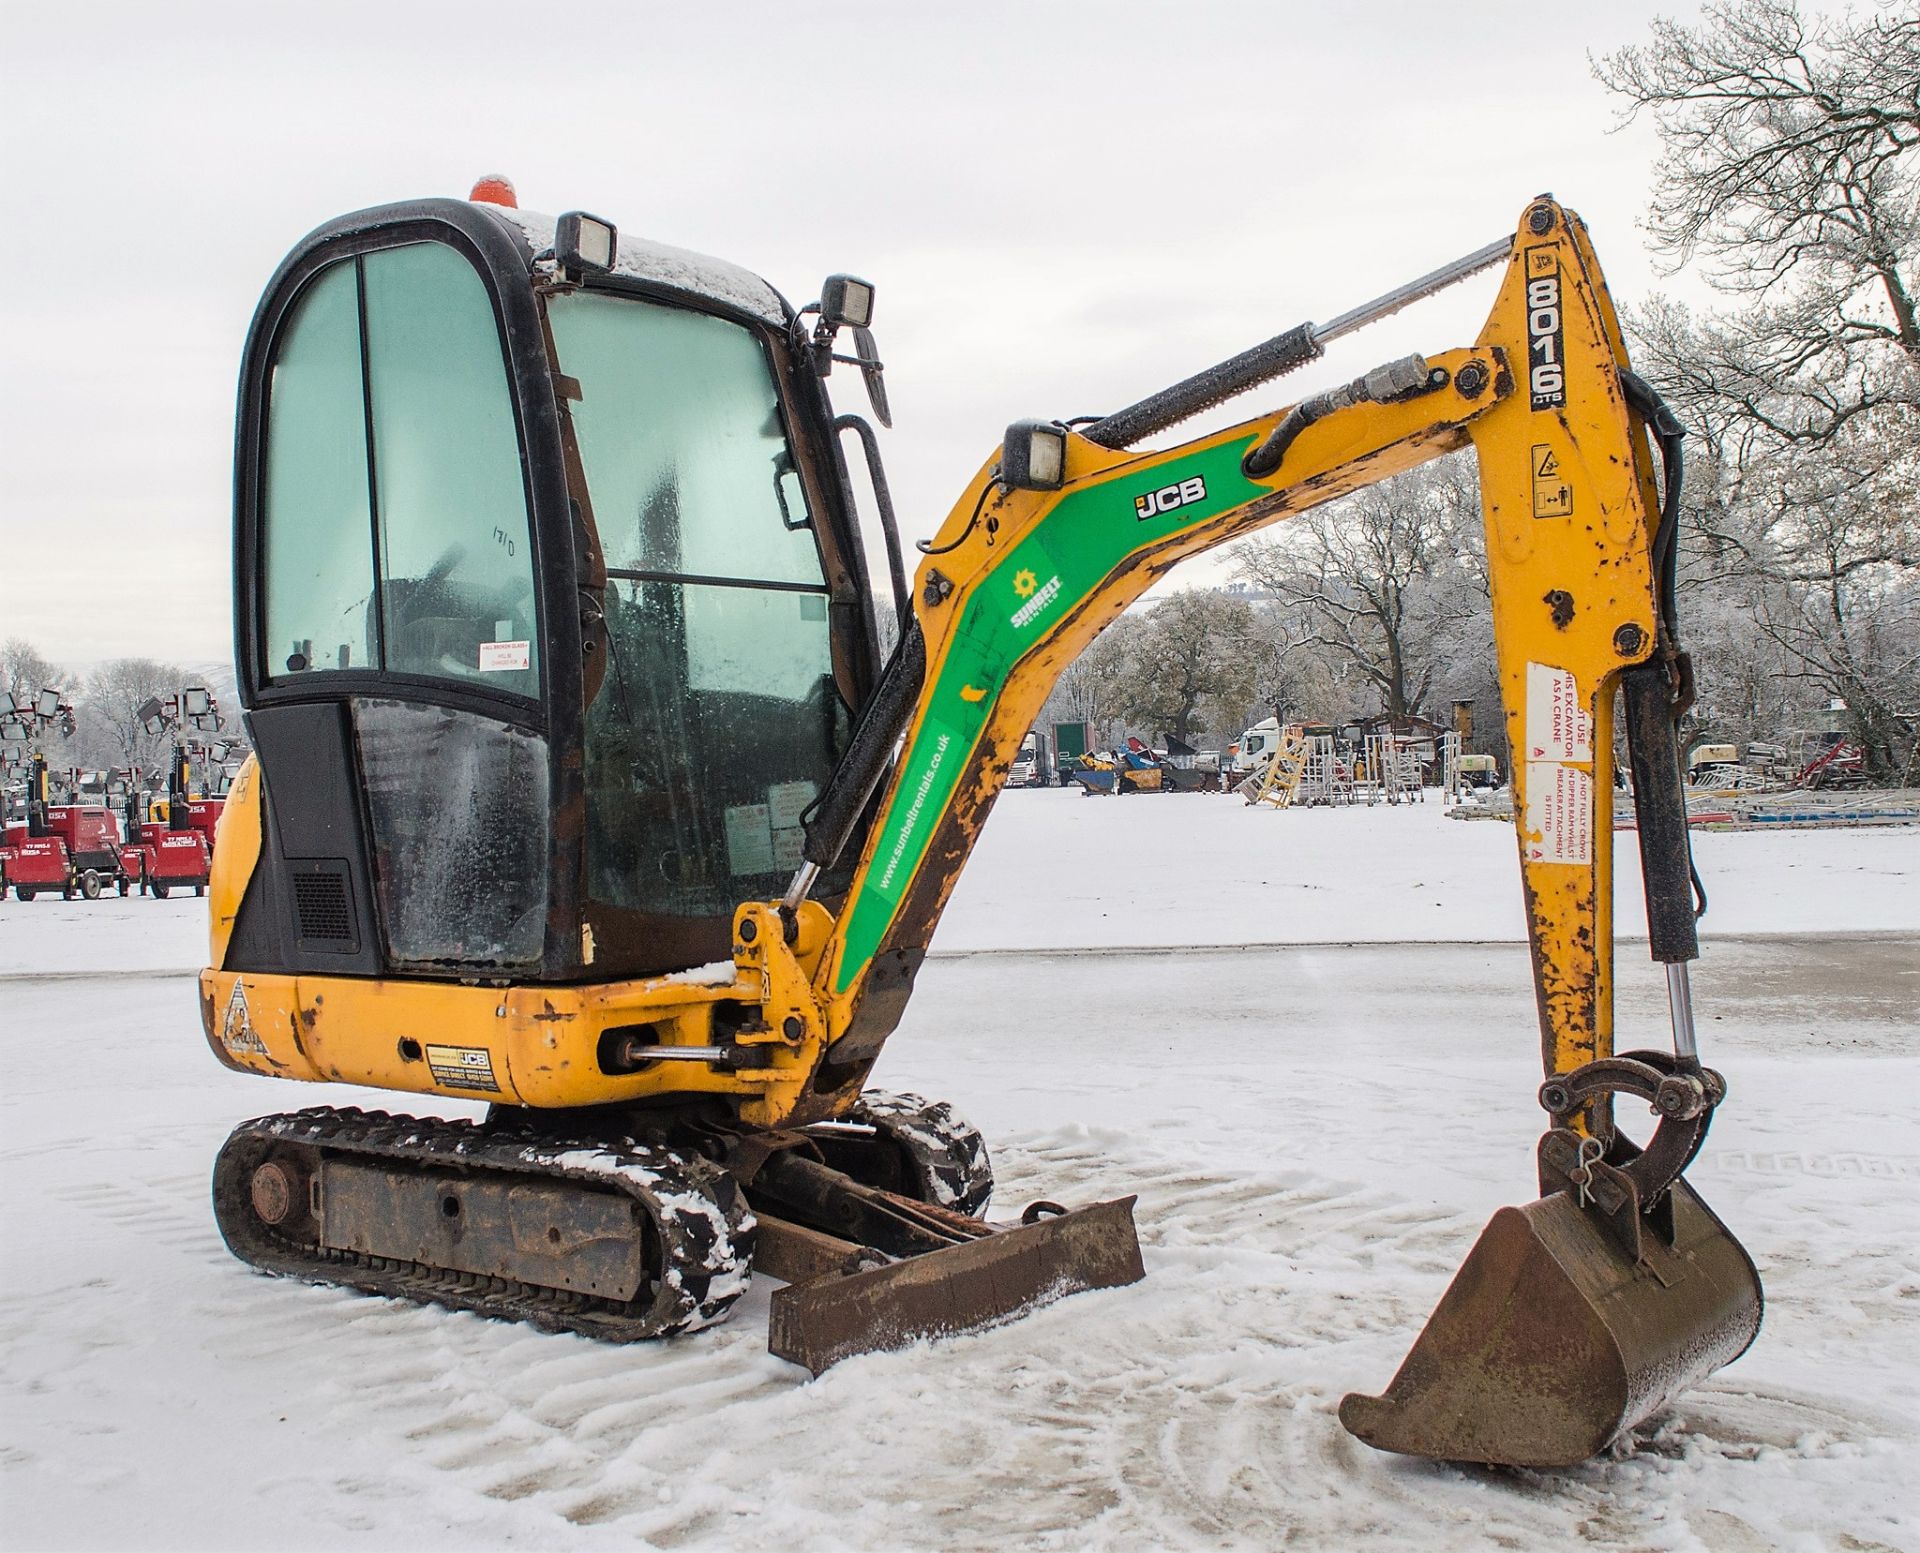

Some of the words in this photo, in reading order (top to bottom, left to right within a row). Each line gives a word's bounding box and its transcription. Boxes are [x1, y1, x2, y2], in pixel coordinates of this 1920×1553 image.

[1535, 254, 1553, 271] JCB
[1528, 278, 1563, 394] 8016
[1137, 477, 1206, 519] JCB
[1010, 575, 1060, 628] SUNBELT
[1022, 592, 1058, 627] RENTALS
[1553, 678, 1561, 693] AS
[1565, 671, 1573, 690] HIS
[1553, 694, 1561, 703] A
[1553, 705, 1561, 744] CRANE
[1565, 692, 1573, 758] EXCAVATOR
[1577, 724, 1585, 745] USE
[1568, 769, 1575, 778] IN
[880, 733, 951, 890] www.sunbeltrentals.co.uk
[1567, 828, 1575, 859] WHILST
[1579, 828, 1587, 860] CROWD
[460, 1053, 487, 1066] JCB
